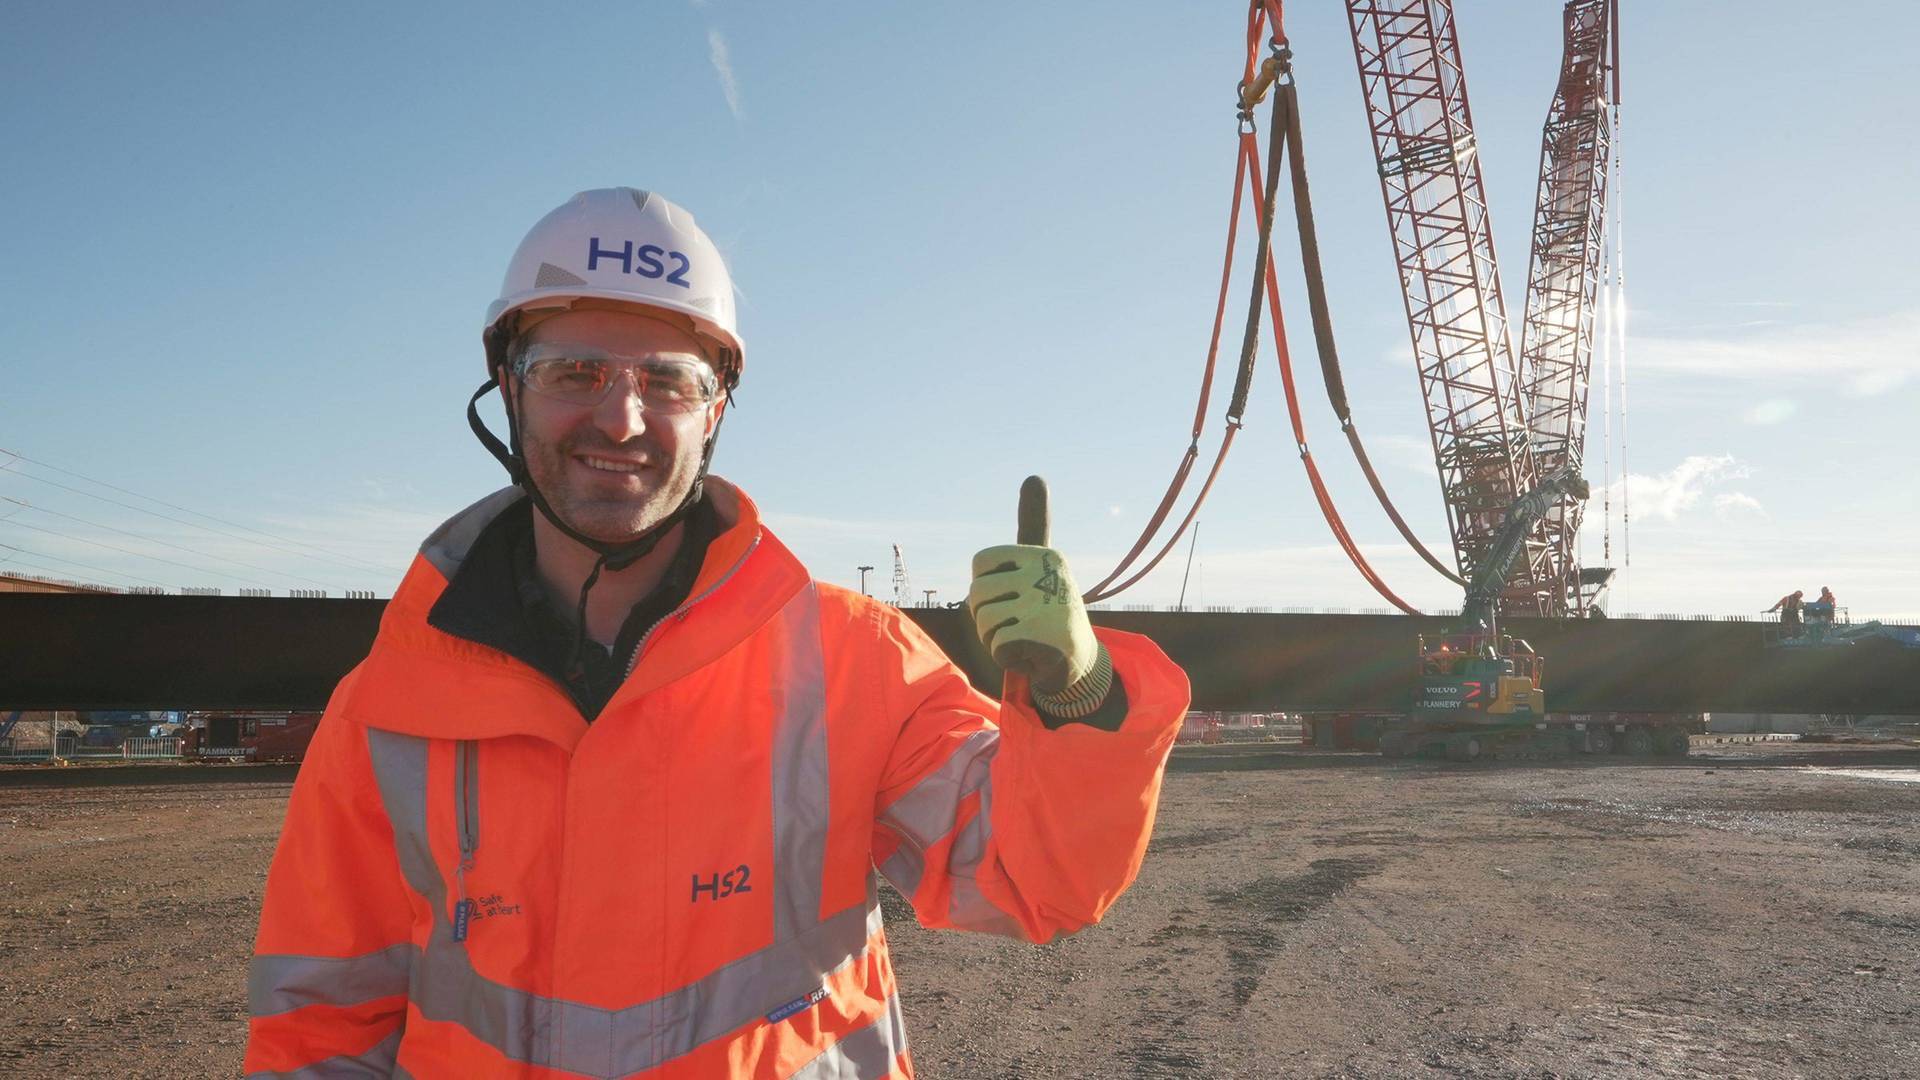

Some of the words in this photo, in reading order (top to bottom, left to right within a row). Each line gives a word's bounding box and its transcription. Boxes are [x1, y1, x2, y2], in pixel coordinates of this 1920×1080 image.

[587, 237, 690, 289] HS2
[1423, 701, 1461, 709] FLANNERY
[691, 864, 752, 903] HS2
